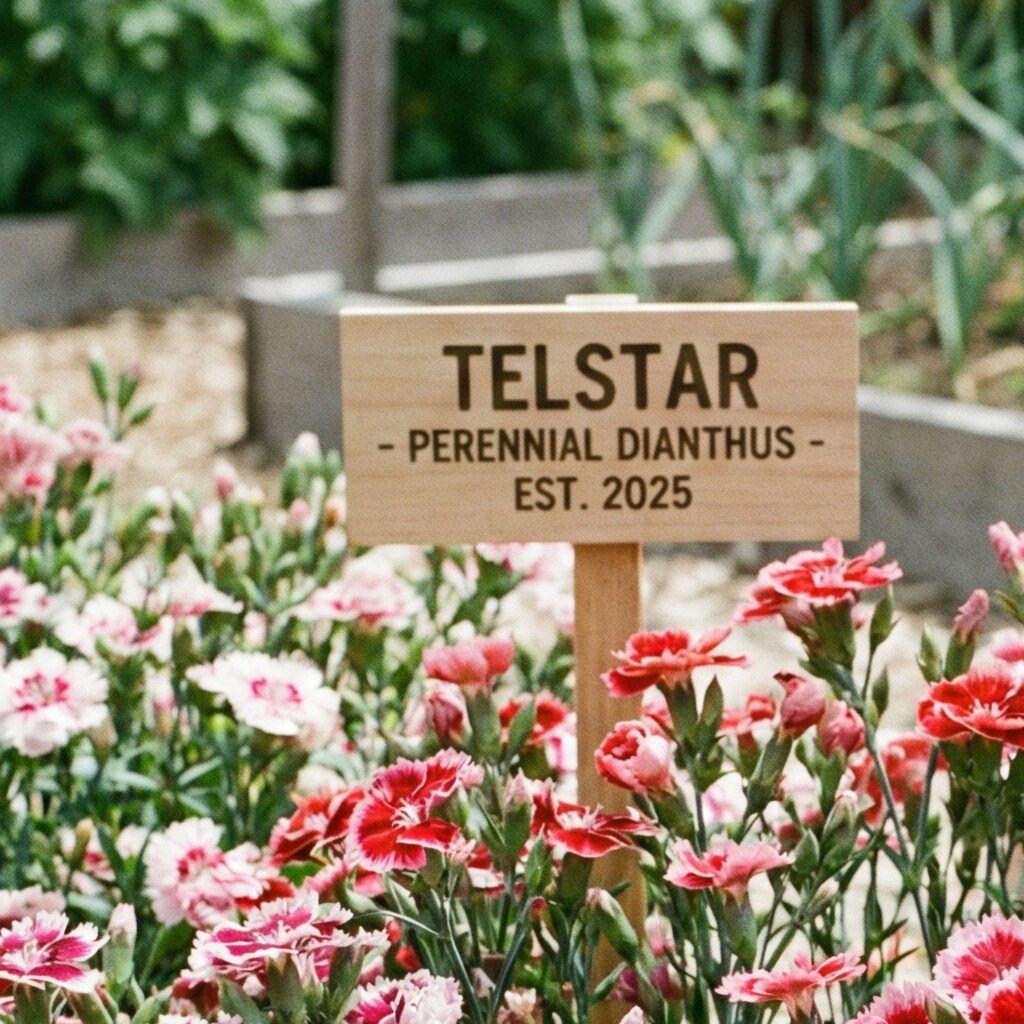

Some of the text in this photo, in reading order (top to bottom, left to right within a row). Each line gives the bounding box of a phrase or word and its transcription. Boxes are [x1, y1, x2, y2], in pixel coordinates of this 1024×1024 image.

[441, 341, 760, 413] TELSTAR
[408, 427, 604, 464] PERENNIAL
[616, 424, 797, 462] DIANTHUS
[513, 474, 694, 513] EST. 2025
